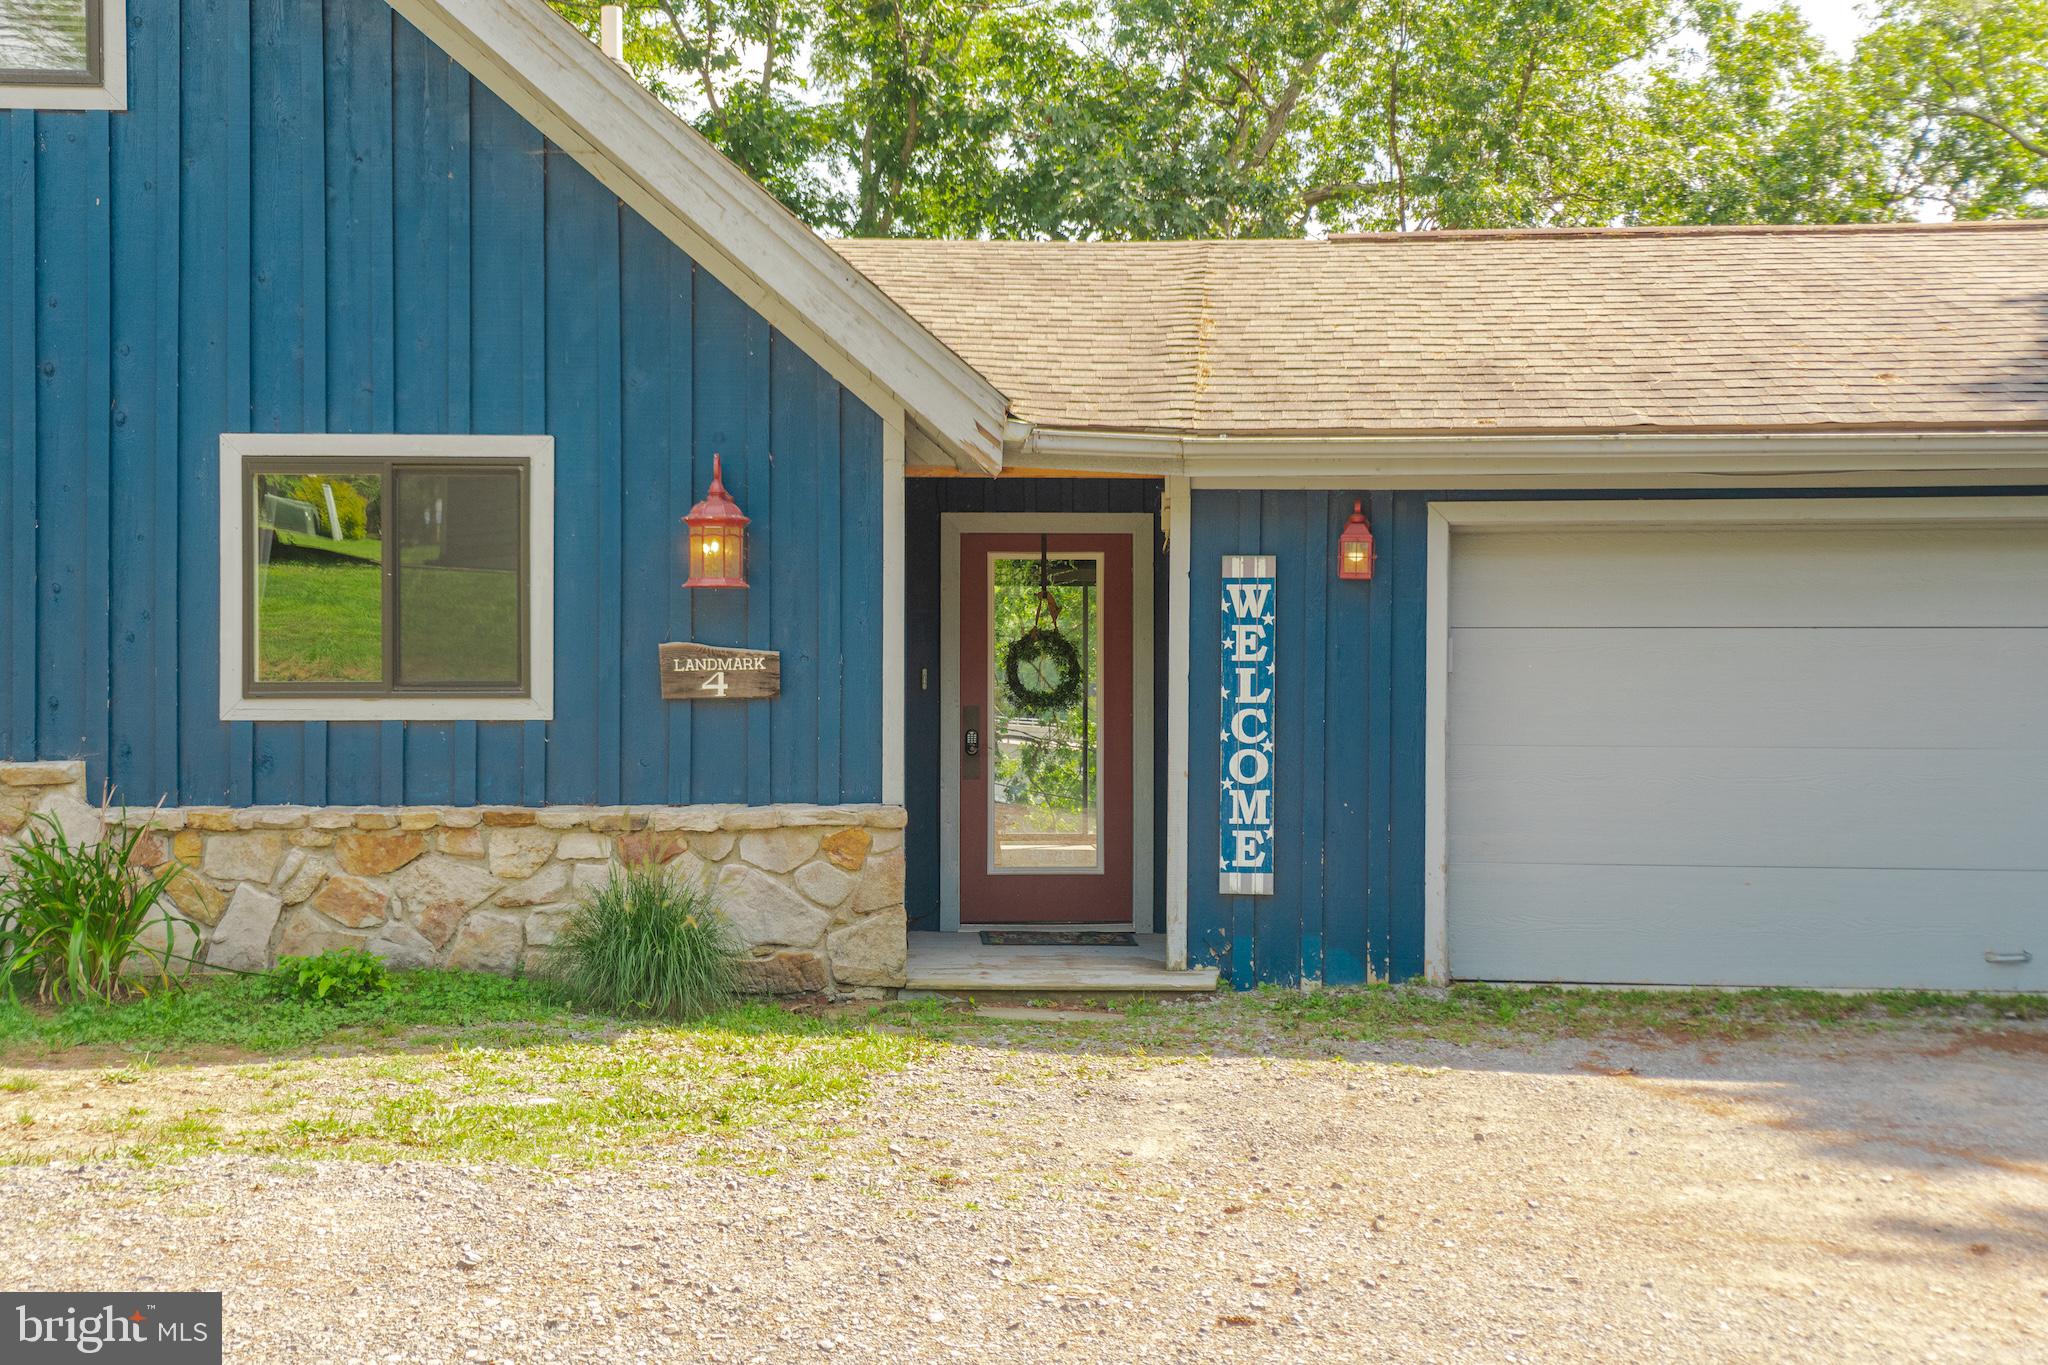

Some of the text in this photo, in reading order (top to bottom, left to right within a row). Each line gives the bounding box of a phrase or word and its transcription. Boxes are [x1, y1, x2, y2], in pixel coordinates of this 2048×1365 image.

[673, 657, 766, 671] LANDMARK
[701, 671, 728, 697] 4
[1226, 583, 1271, 868] WELCOME
